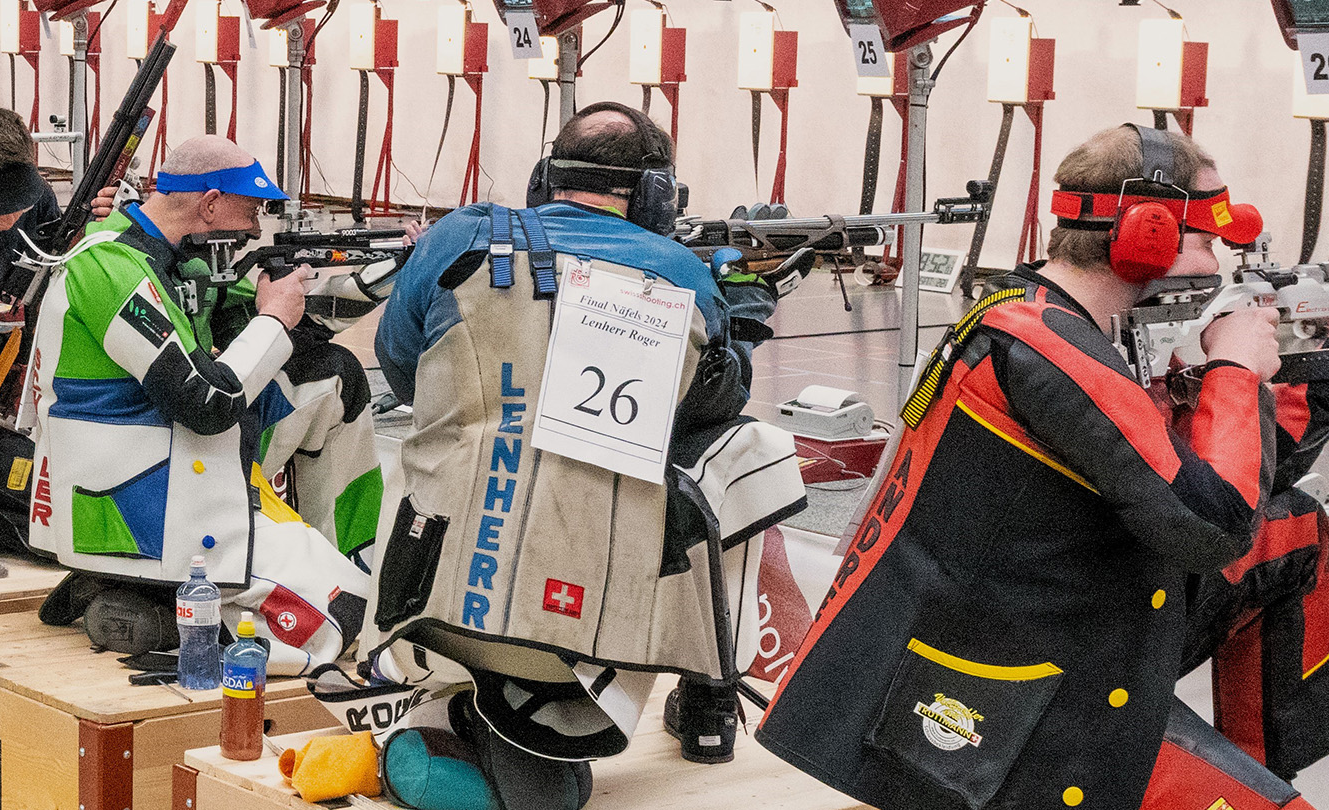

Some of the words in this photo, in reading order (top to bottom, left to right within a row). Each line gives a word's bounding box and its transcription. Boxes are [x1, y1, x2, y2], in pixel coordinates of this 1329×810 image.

[513, 27, 532, 48] 24
[858, 41, 877, 64] 25
[1310, 53, 1329, 80] 2
[579, 294, 608, 310] Final
[610, 303, 641, 320] Näfels
[644, 314, 669, 329] 2024
[581, 315, 626, 336] Lenherr
[629, 329, 661, 348] Roger
[573, 365, 644, 425] 26
[462, 362, 526, 631] LENHERR
